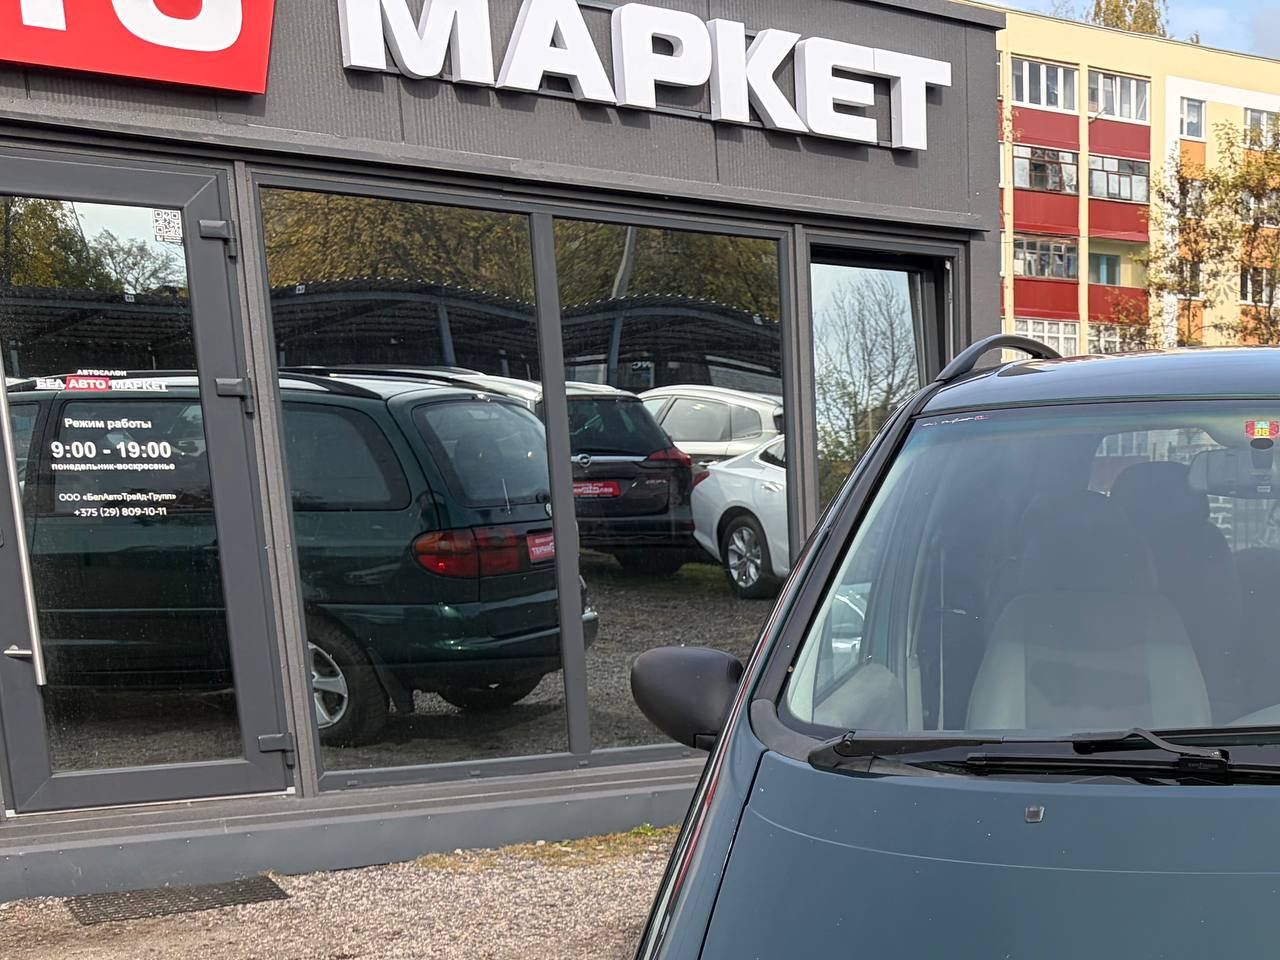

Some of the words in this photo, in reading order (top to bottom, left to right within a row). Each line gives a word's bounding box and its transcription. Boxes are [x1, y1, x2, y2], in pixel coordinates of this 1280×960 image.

[340, 0, 951, 151] МАРКЕТ
[76, 369, 127, 377] АВТОСАЛОН
[64, 418, 104, 428] Режим
[107, 418, 152, 430] работы
[50, 441, 96, 458] 9:00
[116, 441, 171, 458] 19:00
[51, 462, 176, 472] понедельник-воскресенье
[58, 493, 80, 501] ООО
[73, 508, 98, 517] +375
[100, 507, 119, 517] (29)
[121, 507, 167, 517] 809-10-11
